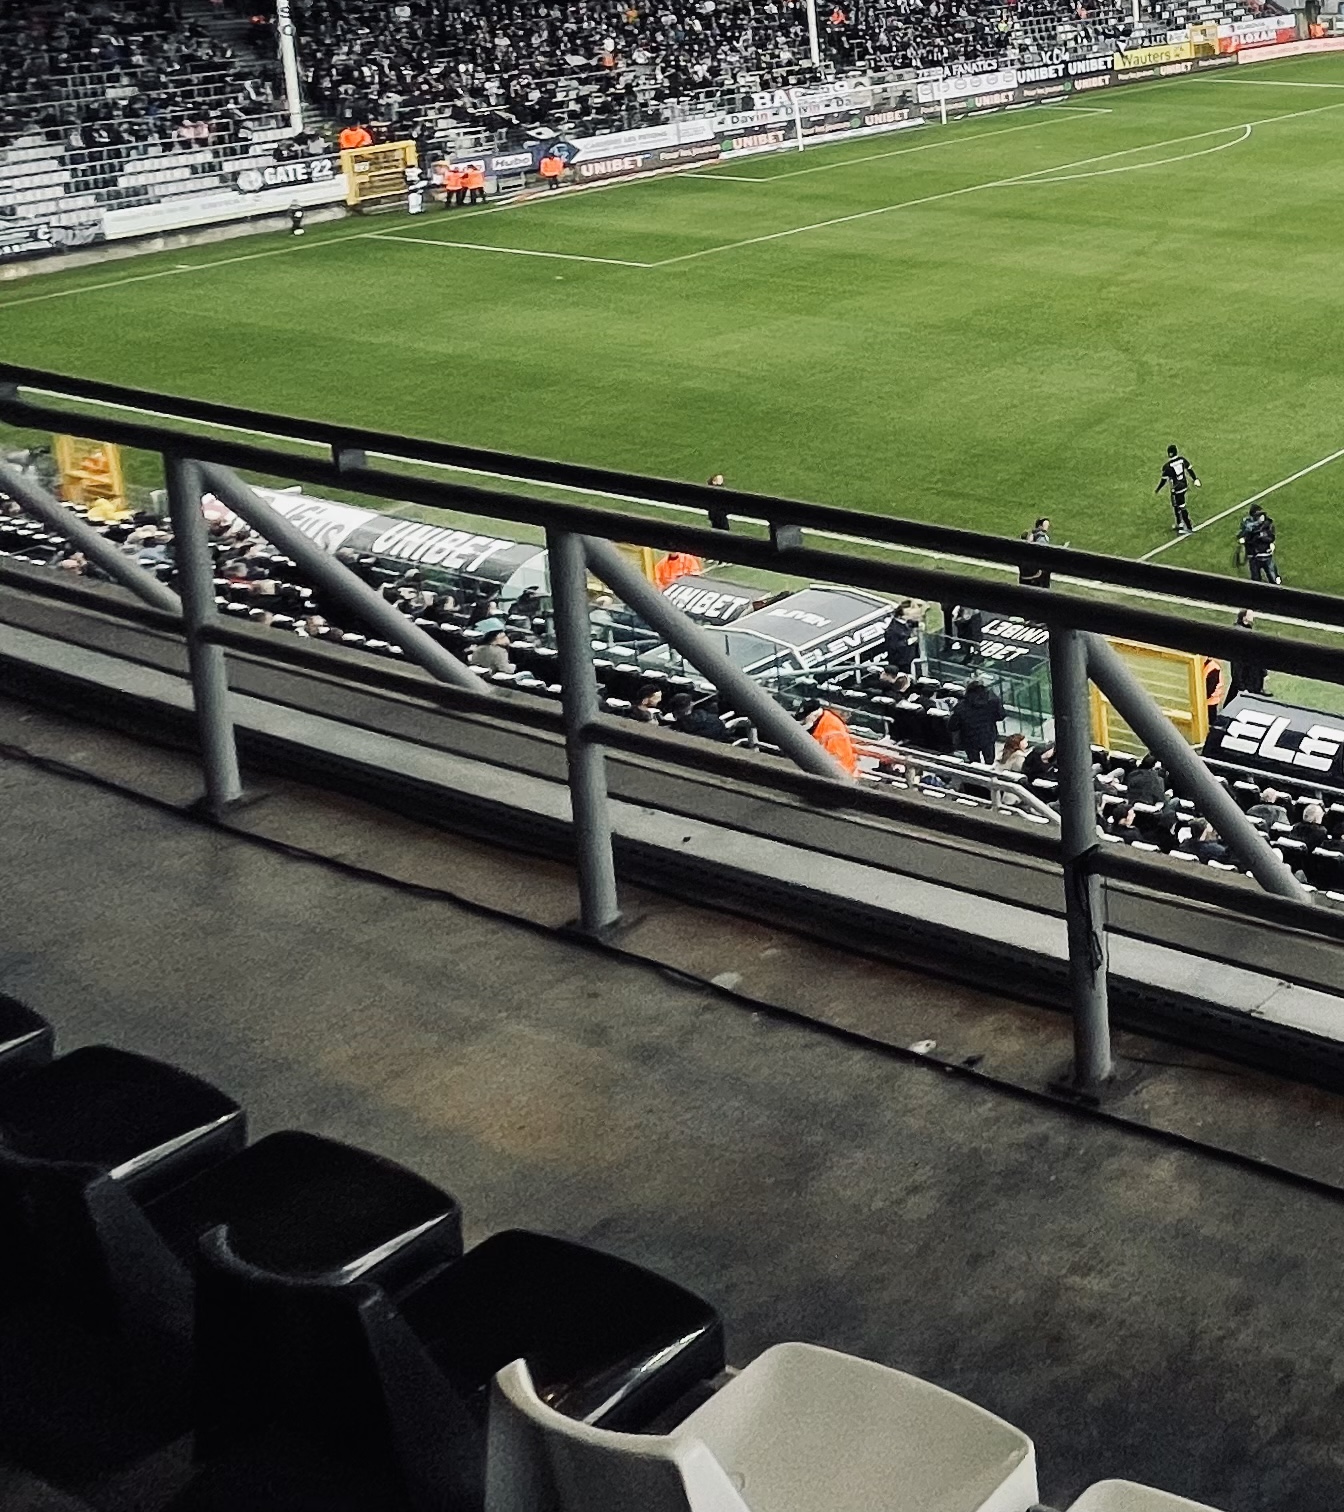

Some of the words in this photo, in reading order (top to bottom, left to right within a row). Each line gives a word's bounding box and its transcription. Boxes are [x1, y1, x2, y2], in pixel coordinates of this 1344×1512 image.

[1121, 49, 1171, 67] Wauters
[953, 59, 998, 77] FANATICS
[1017, 63, 1066, 84] UNIBET
[1068, 56, 1115, 75] UNIBET
[975, 90, 1015, 107] UNIBET
[731, 111, 769, 126] Davin
[785, 102, 820, 116] Dvin
[864, 109, 910, 126] UNIBET
[732, 130, 786, 150] UNIBET
[264, 162, 308, 186] GATE
[310, 158, 334, 178] 22
[581, 155, 643, 176] UNIBET
[372, 519, 516, 573] UNIBET
[979, 639, 1030, 662] IBET
